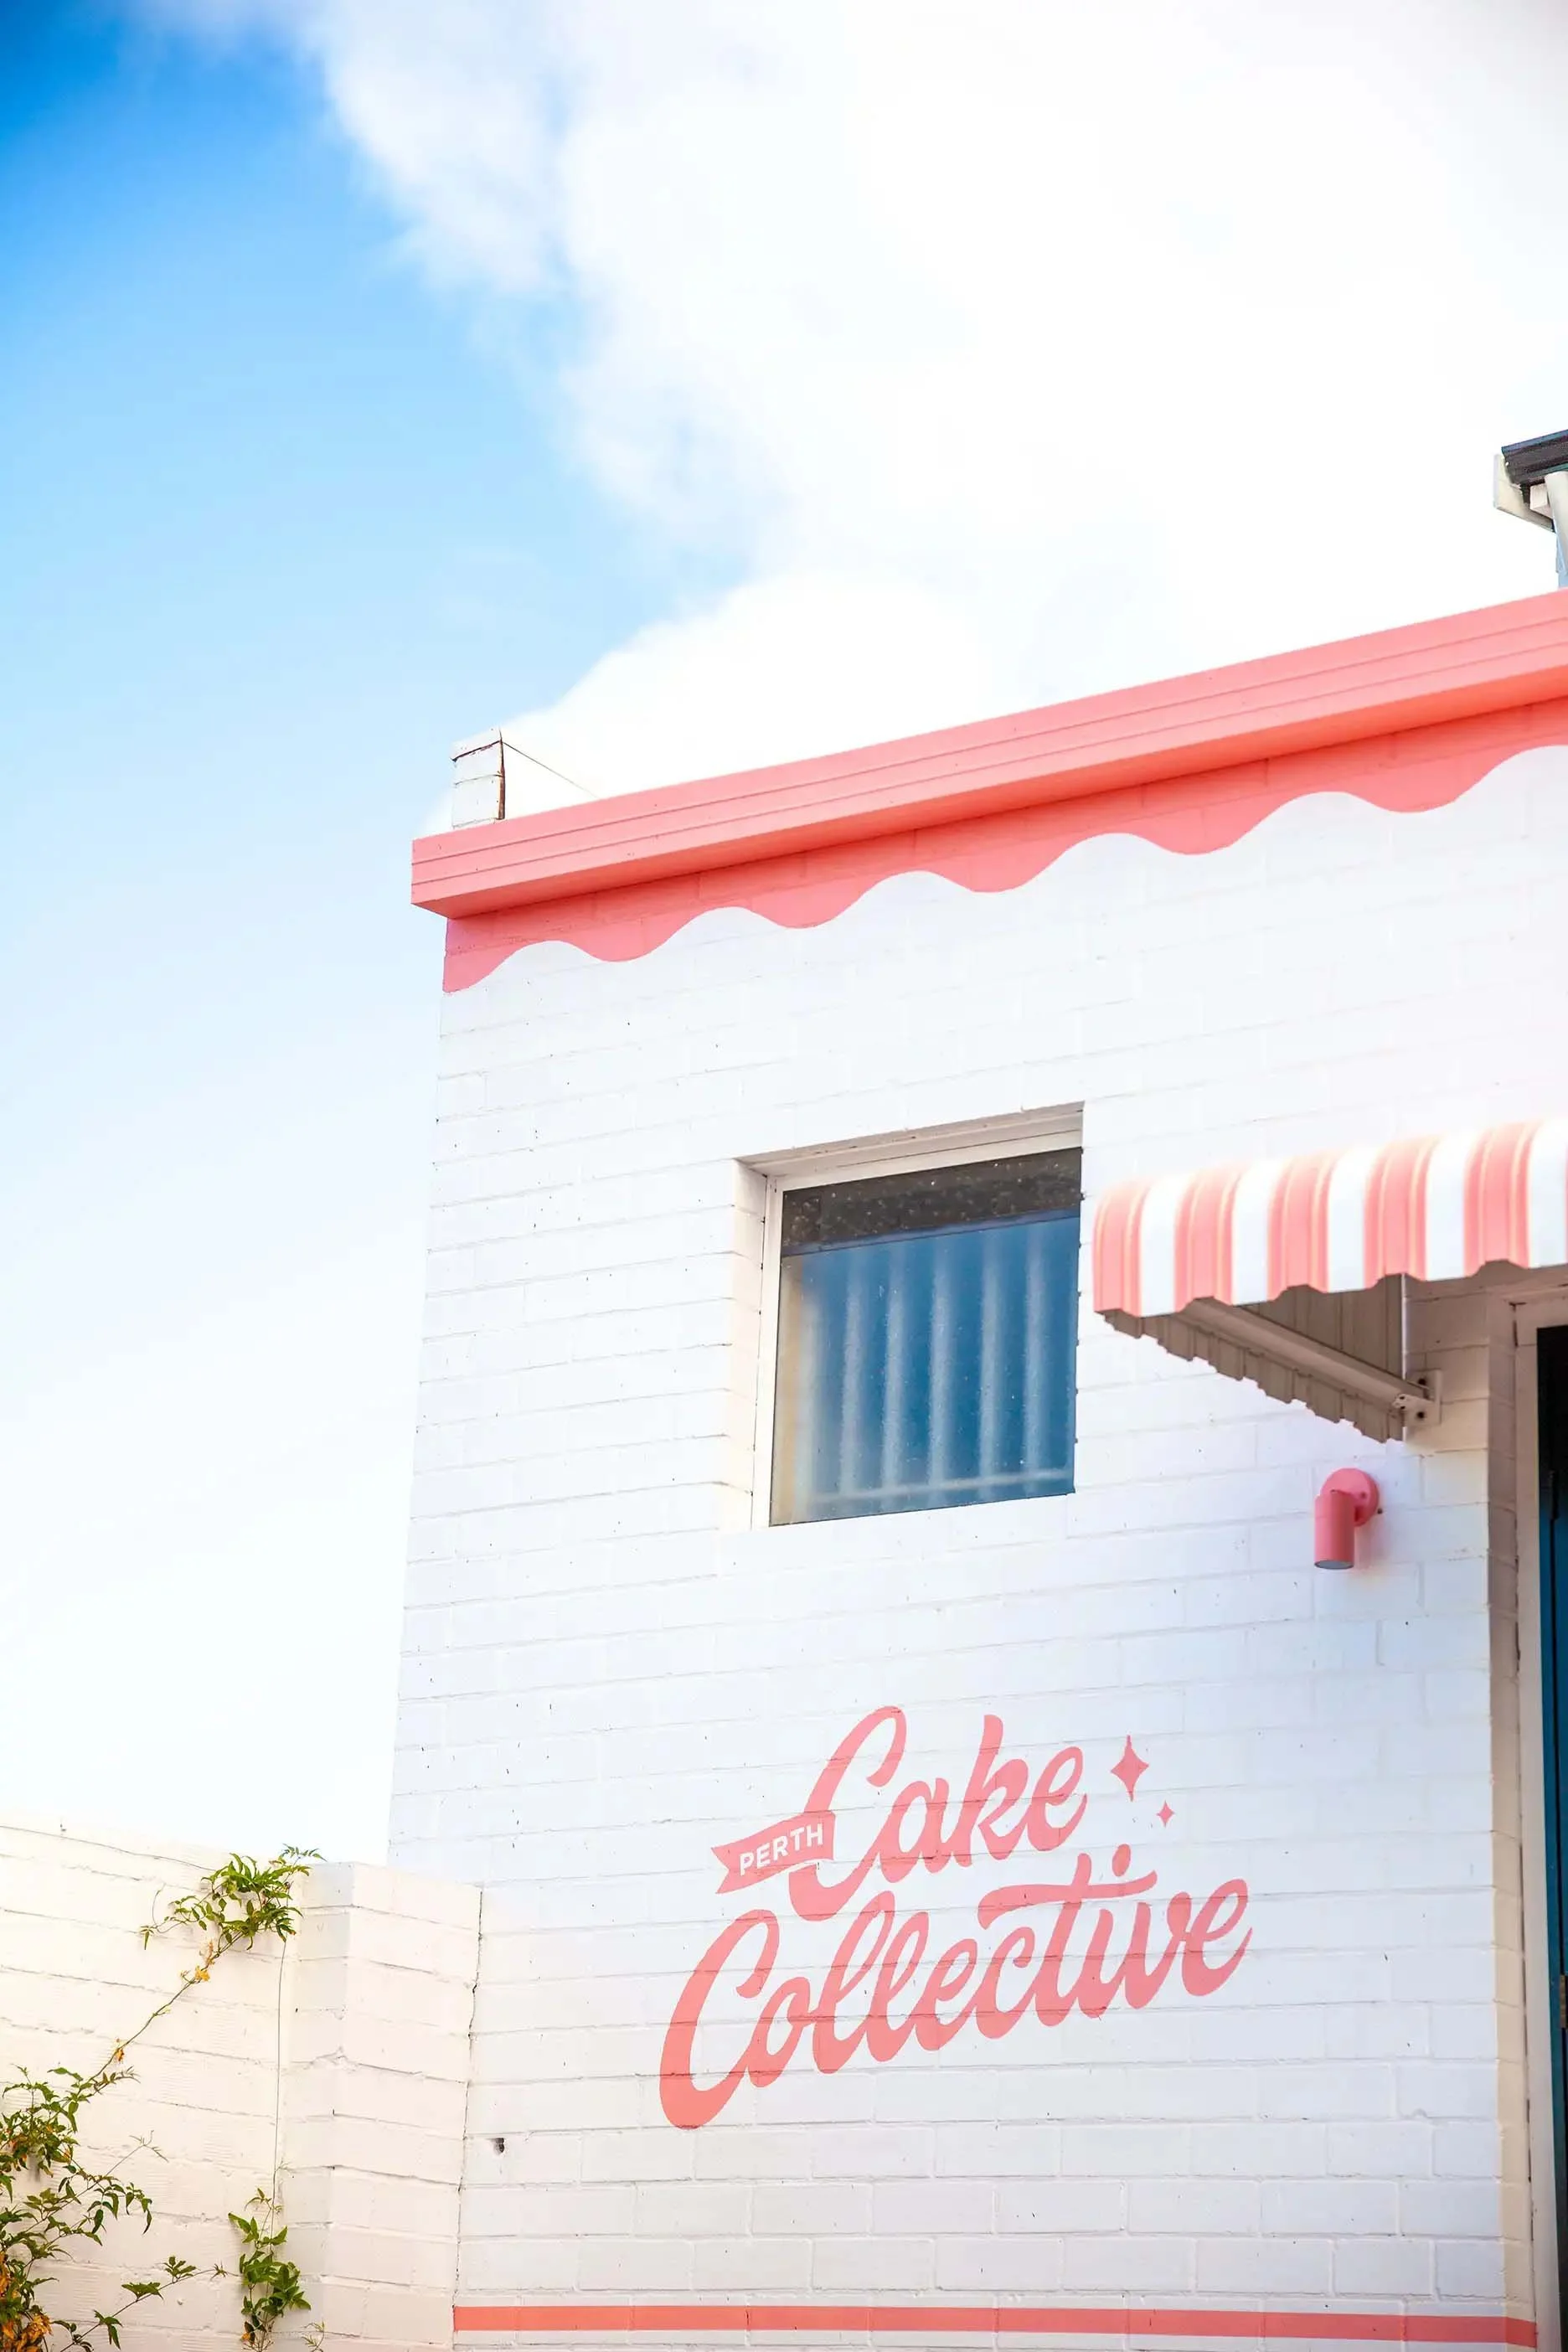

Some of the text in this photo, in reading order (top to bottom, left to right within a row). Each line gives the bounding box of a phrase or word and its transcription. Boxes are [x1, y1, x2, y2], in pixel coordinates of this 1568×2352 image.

[739, 1823, 823, 1876] PERTH
[788, 1705, 1087, 1921] Cake
[659, 1844, 1252, 2130] Collective
